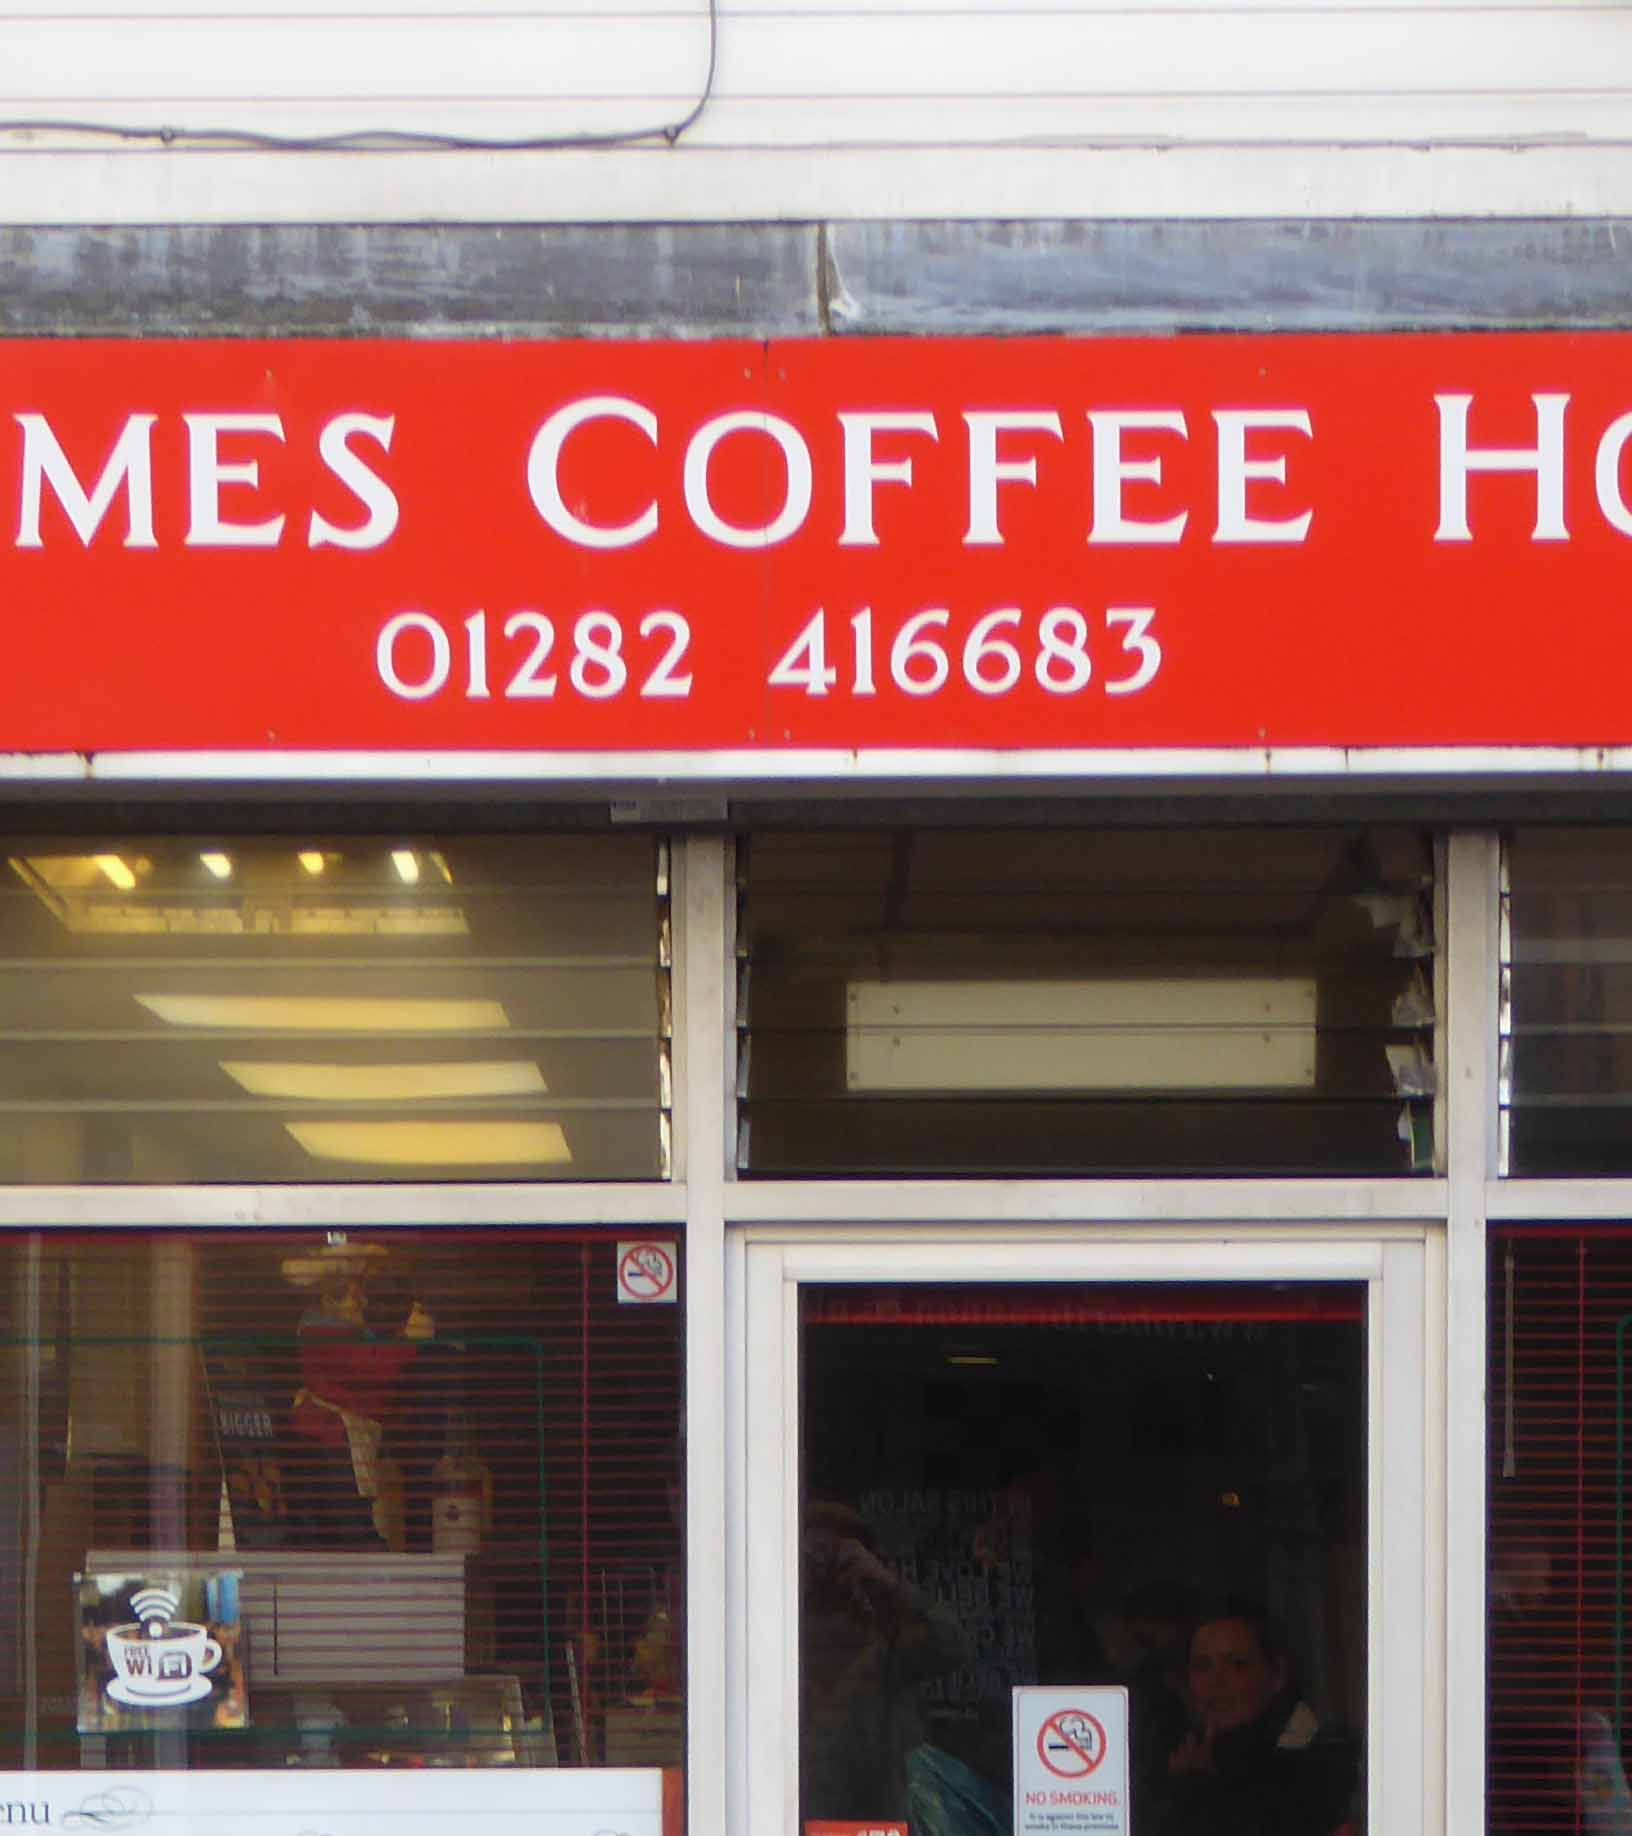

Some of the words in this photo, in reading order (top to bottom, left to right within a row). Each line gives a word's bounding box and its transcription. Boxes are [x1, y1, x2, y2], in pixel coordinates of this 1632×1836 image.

[528, 396, 1313, 548] COFFEE
[377, 610, 693, 699] 01282
[768, 607, 1162, 695] 416683
[1025, 1791, 1046, 1806] NO
